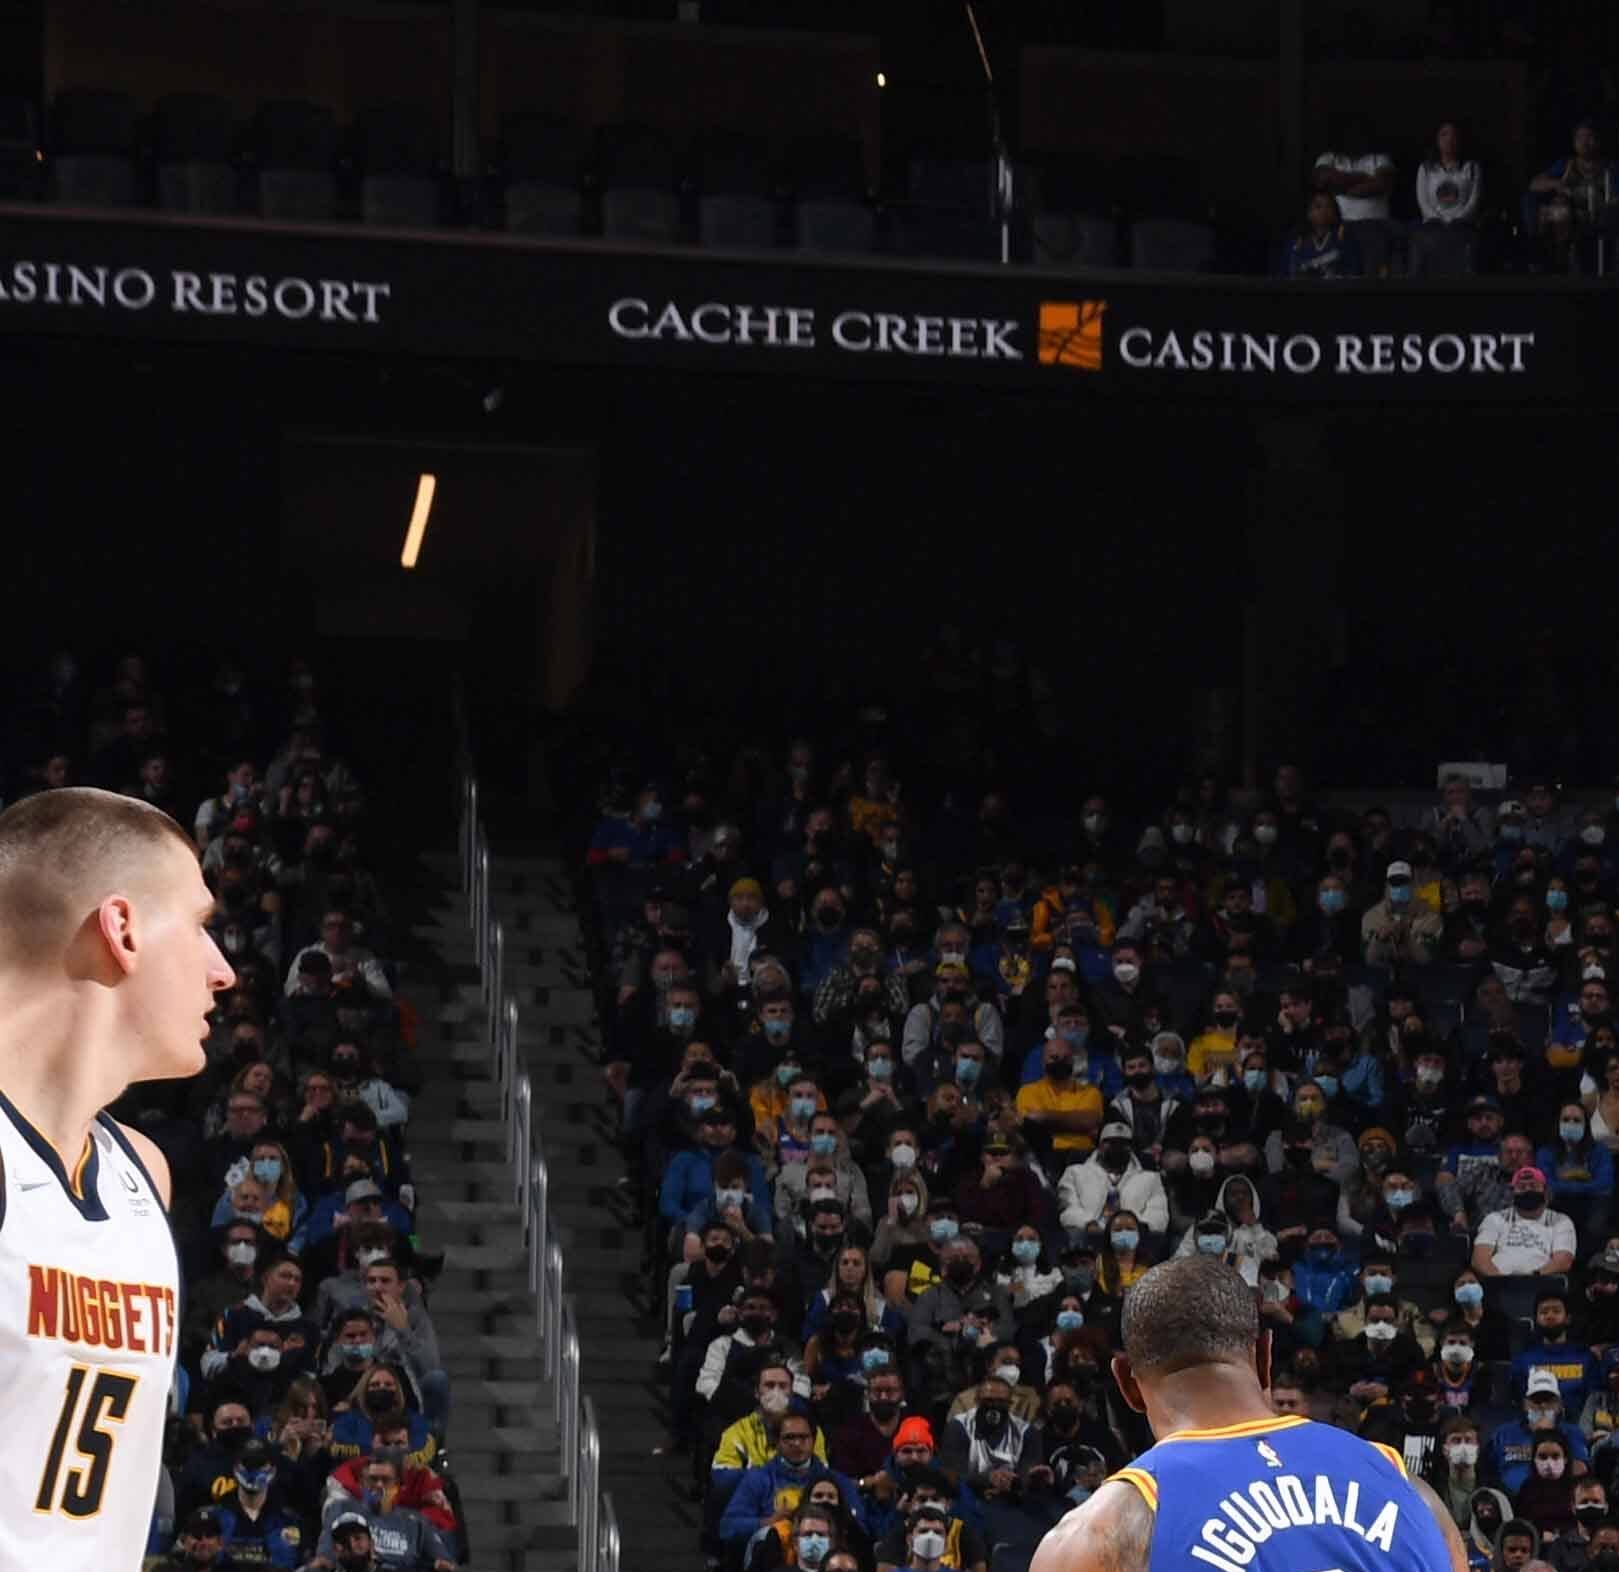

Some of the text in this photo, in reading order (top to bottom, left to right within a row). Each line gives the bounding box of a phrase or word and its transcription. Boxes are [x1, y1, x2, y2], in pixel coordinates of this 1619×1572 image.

[171, 271, 391, 322] RESORT
[607, 300, 1536, 373] CACHE CREEK CASINO RESORT
[26, 1262, 176, 1358] NUGGETS
[31, 1365, 141, 1521] 15
